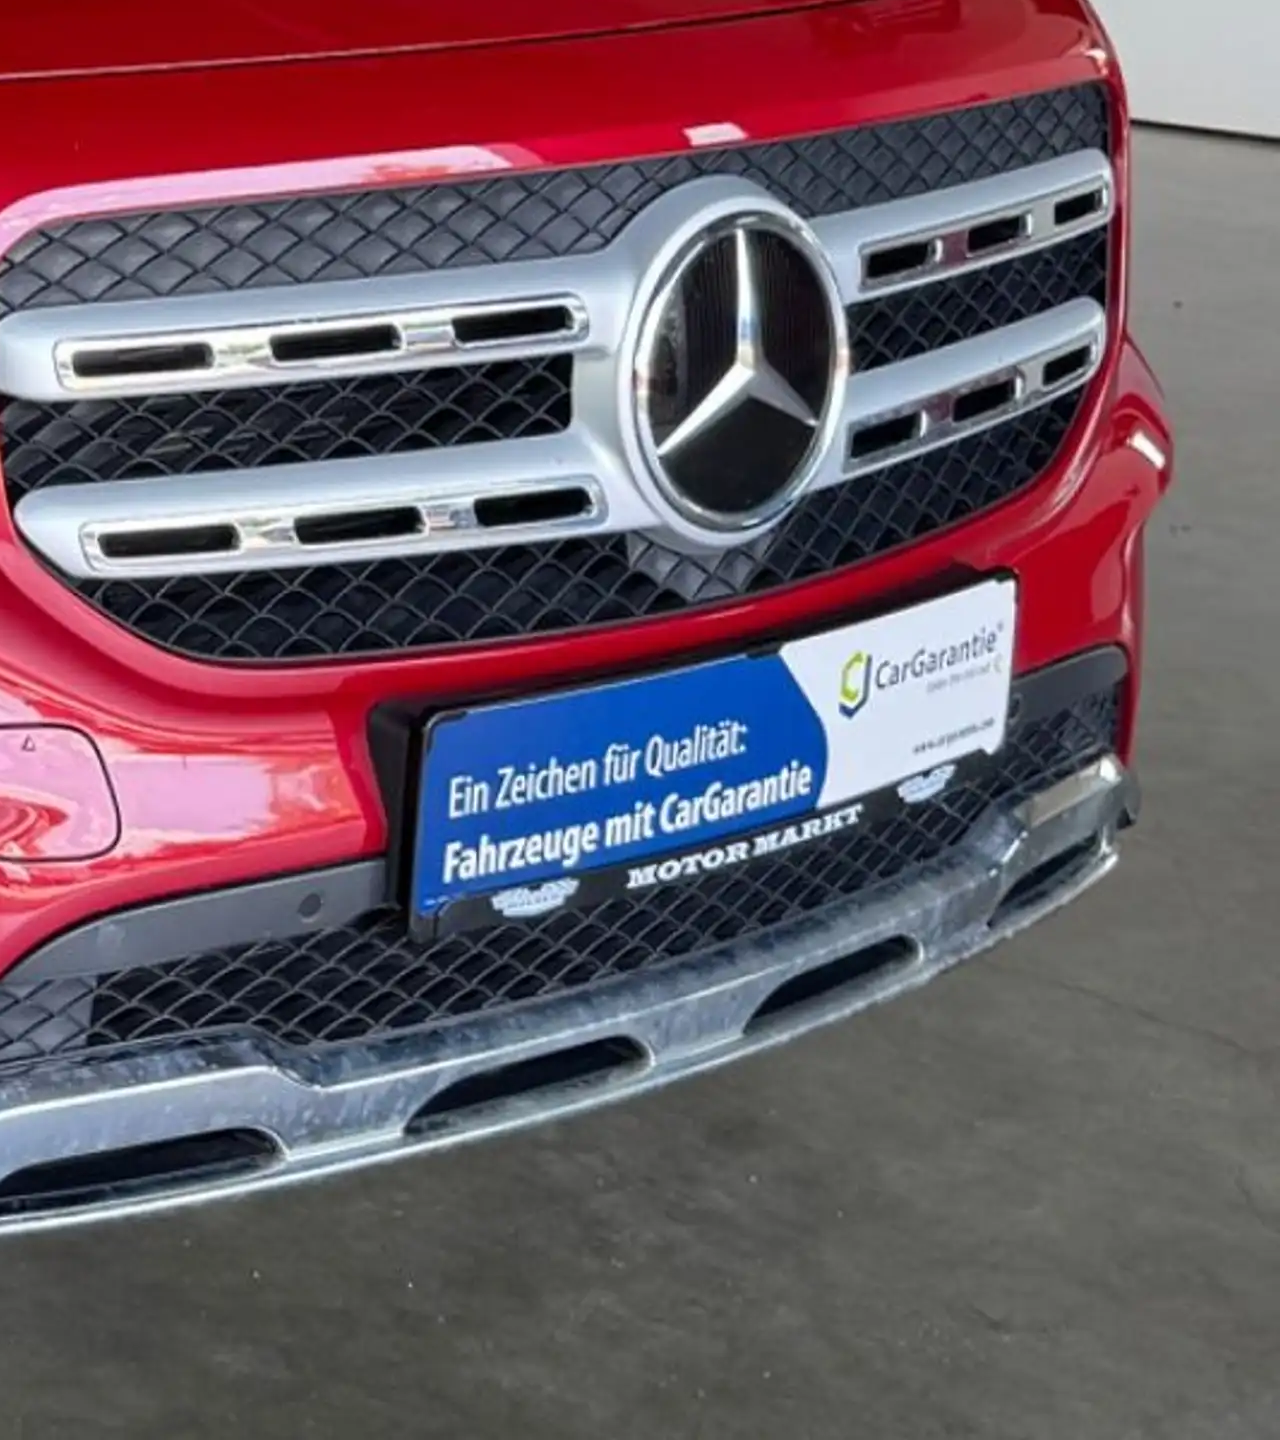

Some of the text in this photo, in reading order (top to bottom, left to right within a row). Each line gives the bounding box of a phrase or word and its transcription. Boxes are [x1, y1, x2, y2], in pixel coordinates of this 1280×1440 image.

[448, 718, 748, 819] Ein Zeichen für Qualität:
[442, 759, 813, 884] Fahrzeuge mit CarGarantie
[626, 802, 864, 889] MOTOR MARKT
